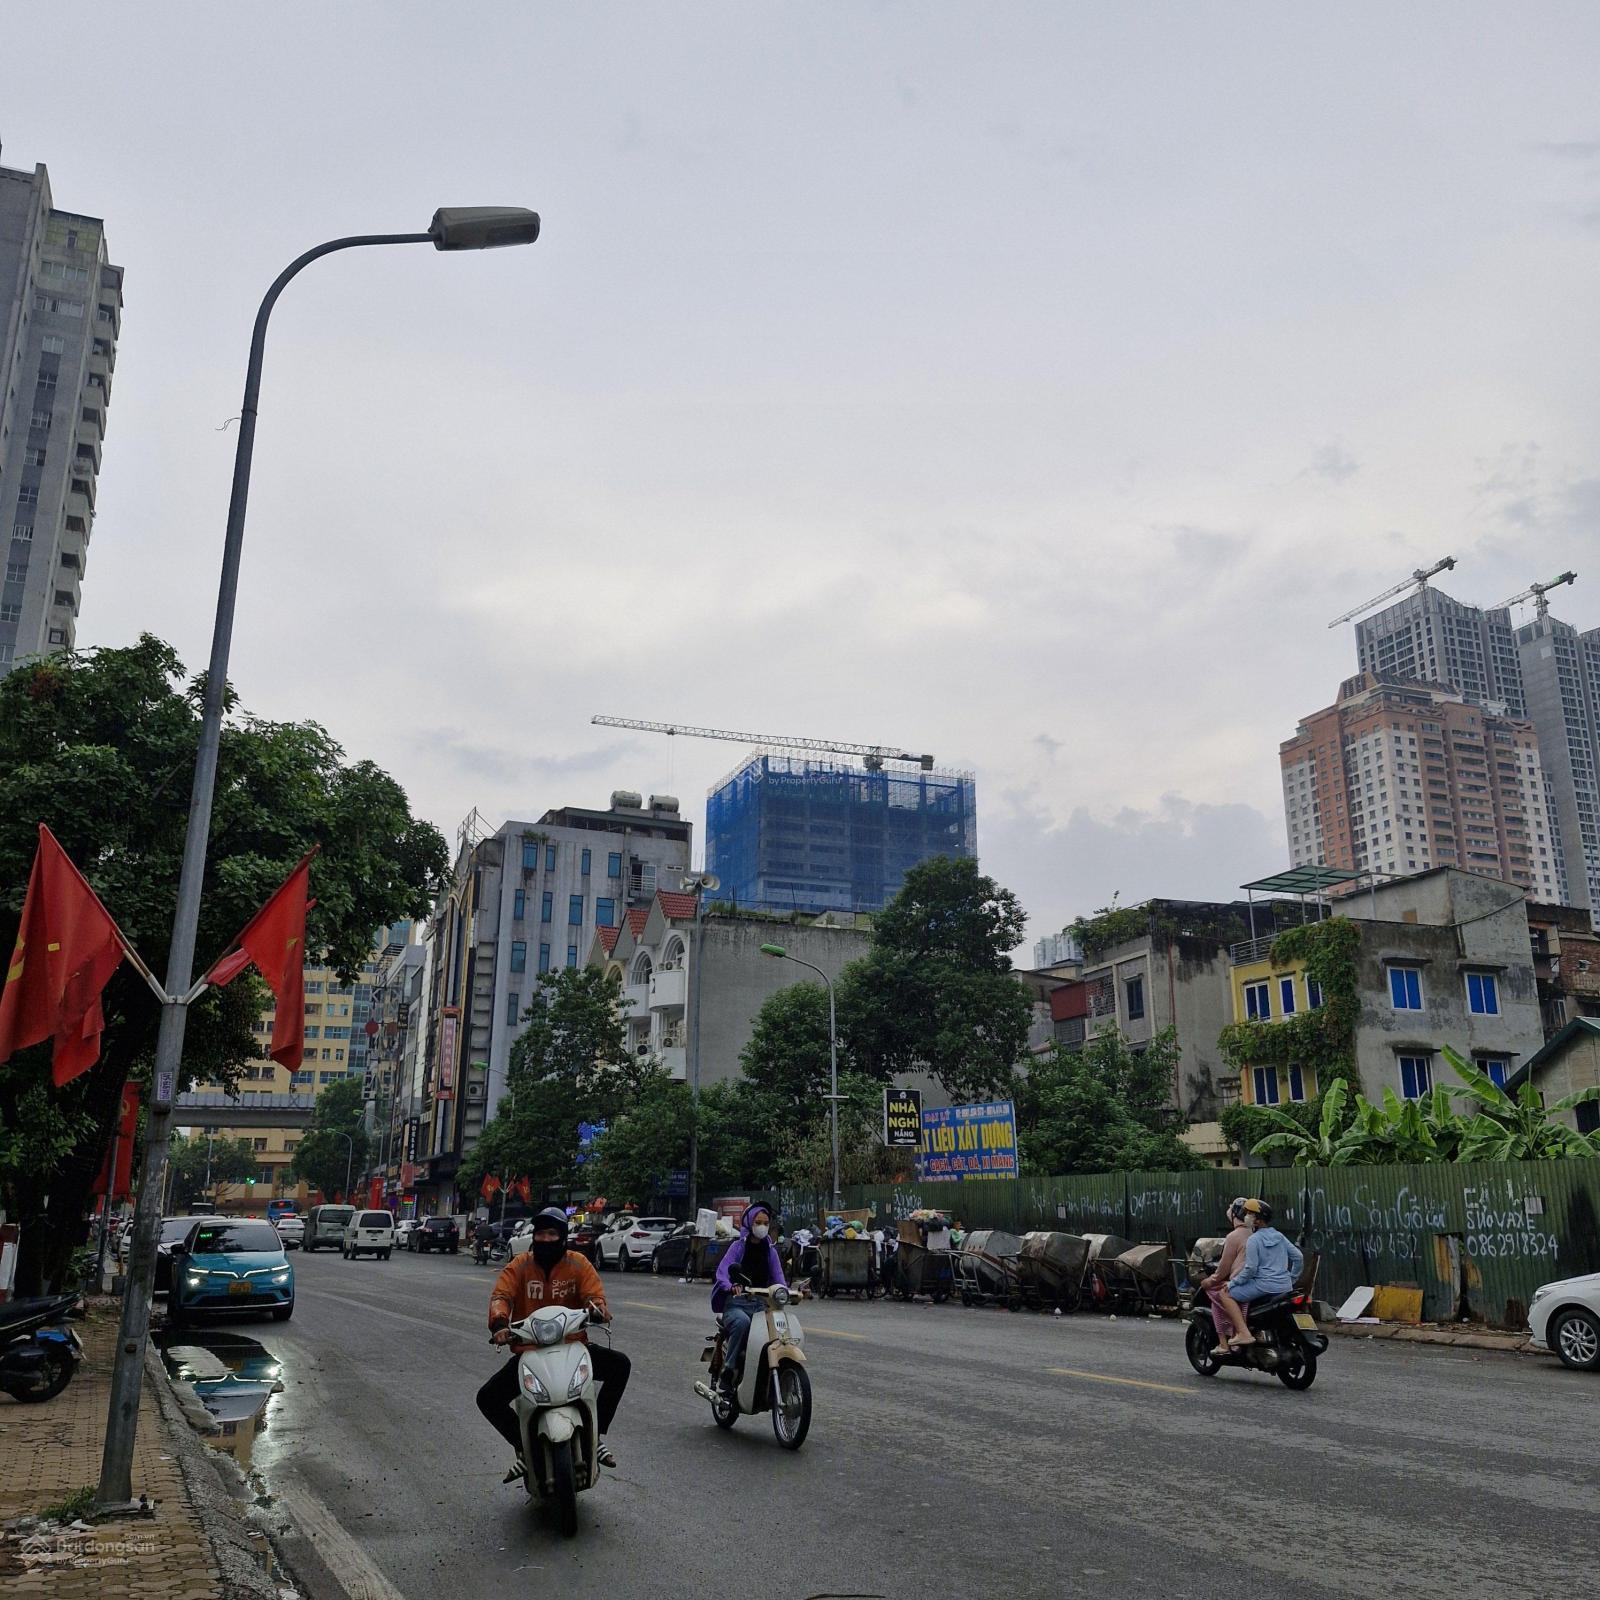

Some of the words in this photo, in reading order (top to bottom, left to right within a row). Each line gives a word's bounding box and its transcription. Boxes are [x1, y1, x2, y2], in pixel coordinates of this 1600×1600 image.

[889, 1100, 916, 1113] NHÀ
[888, 1113, 919, 1128] NGHỈ
[932, 1122, 955, 1156] LIỆU
[957, 1120, 978, 1150] XÂY
[981, 1120, 1013, 1155] DỰNG
[982, 1155, 990, 1169] XI
[991, 1152, 1014, 1168] MĂNG
